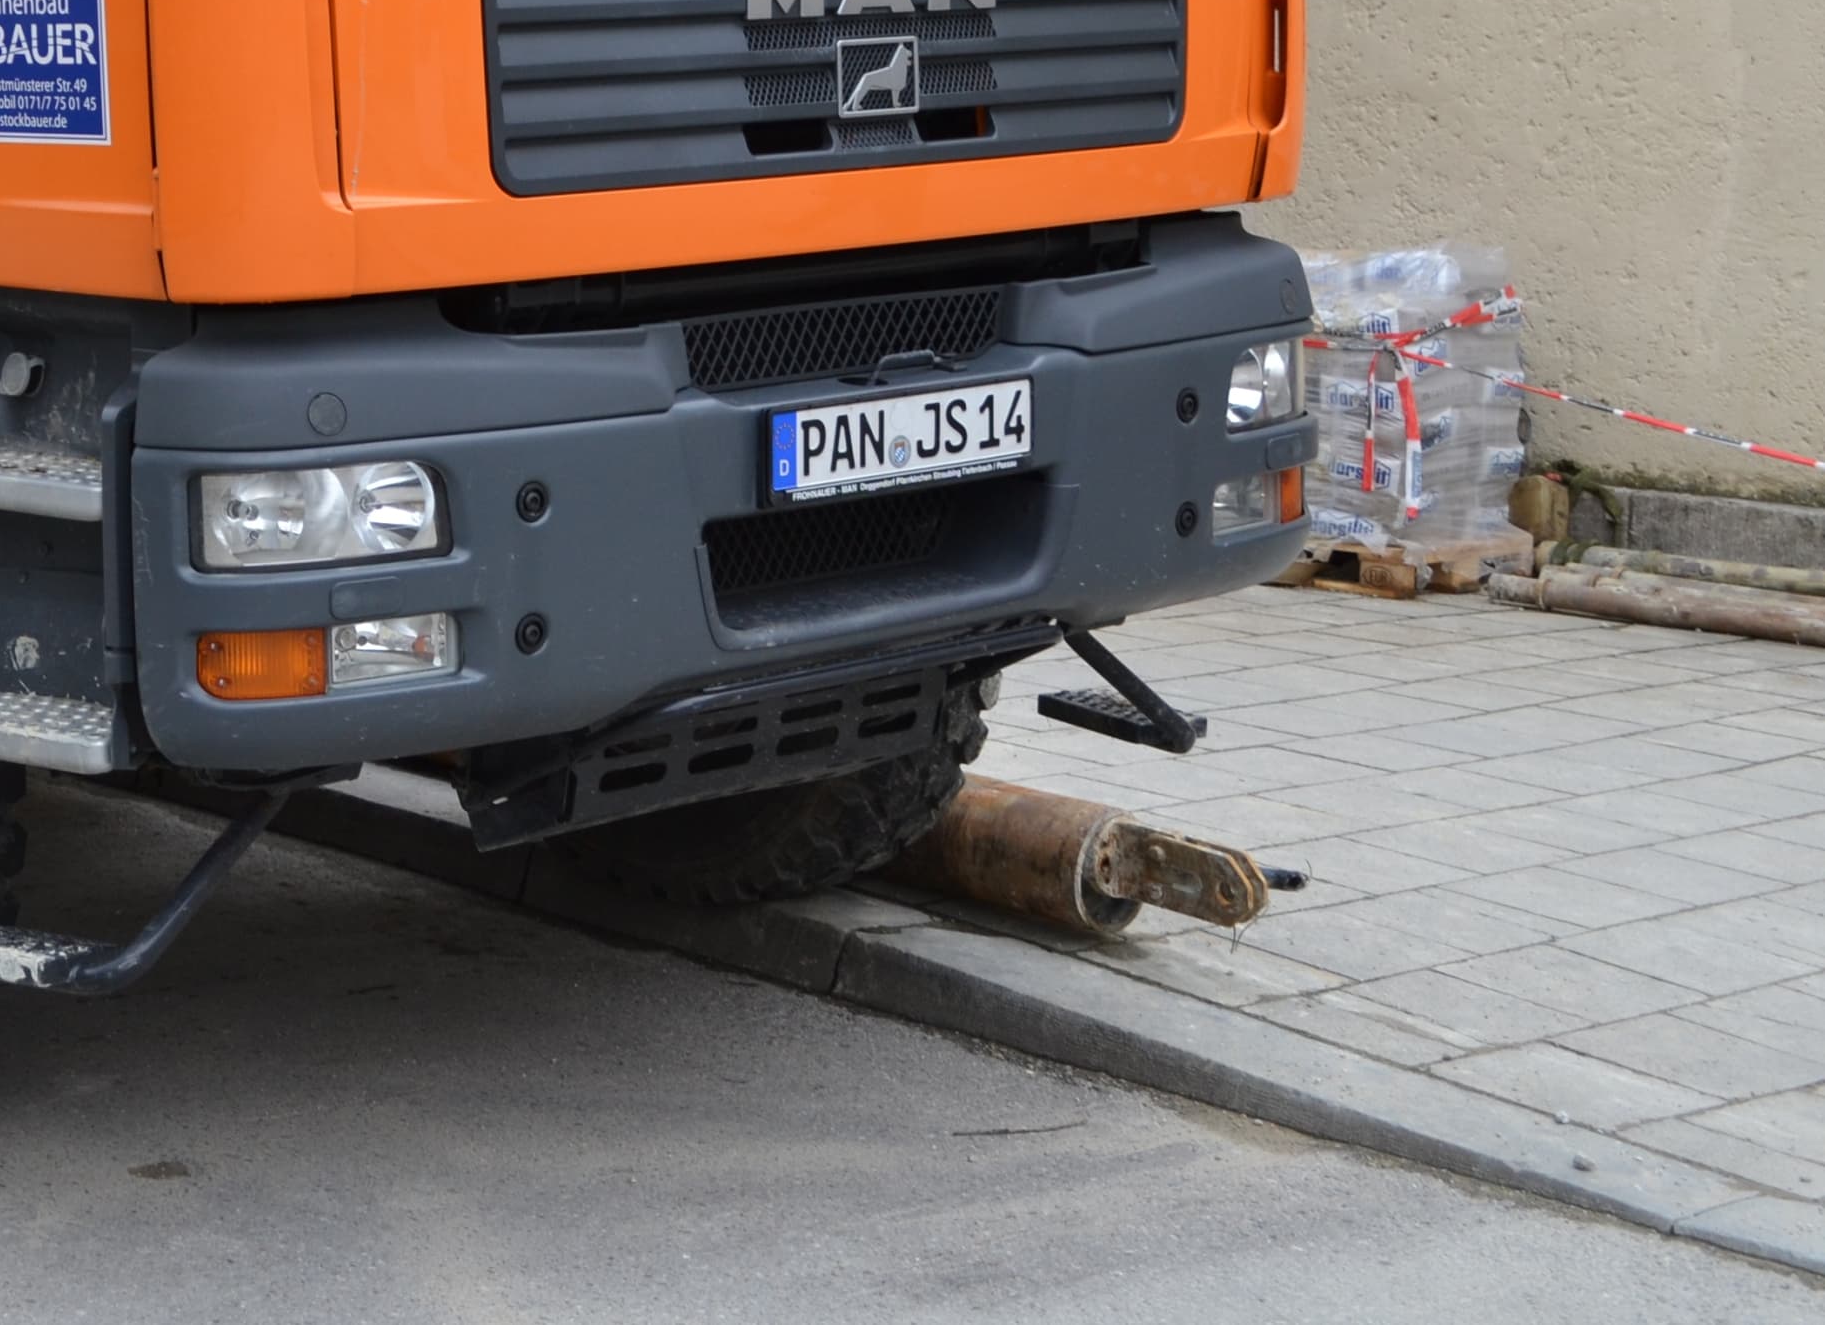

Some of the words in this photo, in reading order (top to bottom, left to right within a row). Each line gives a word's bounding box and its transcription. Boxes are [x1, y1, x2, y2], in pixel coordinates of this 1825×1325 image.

[18, 96, 51, 111] 0171/7
[83, 97, 97, 112] 45
[800, 410, 885, 477] PAN
[916, 399, 968, 459] JS
[979, 390, 1025, 450] 14
[779, 460, 790, 477] D
